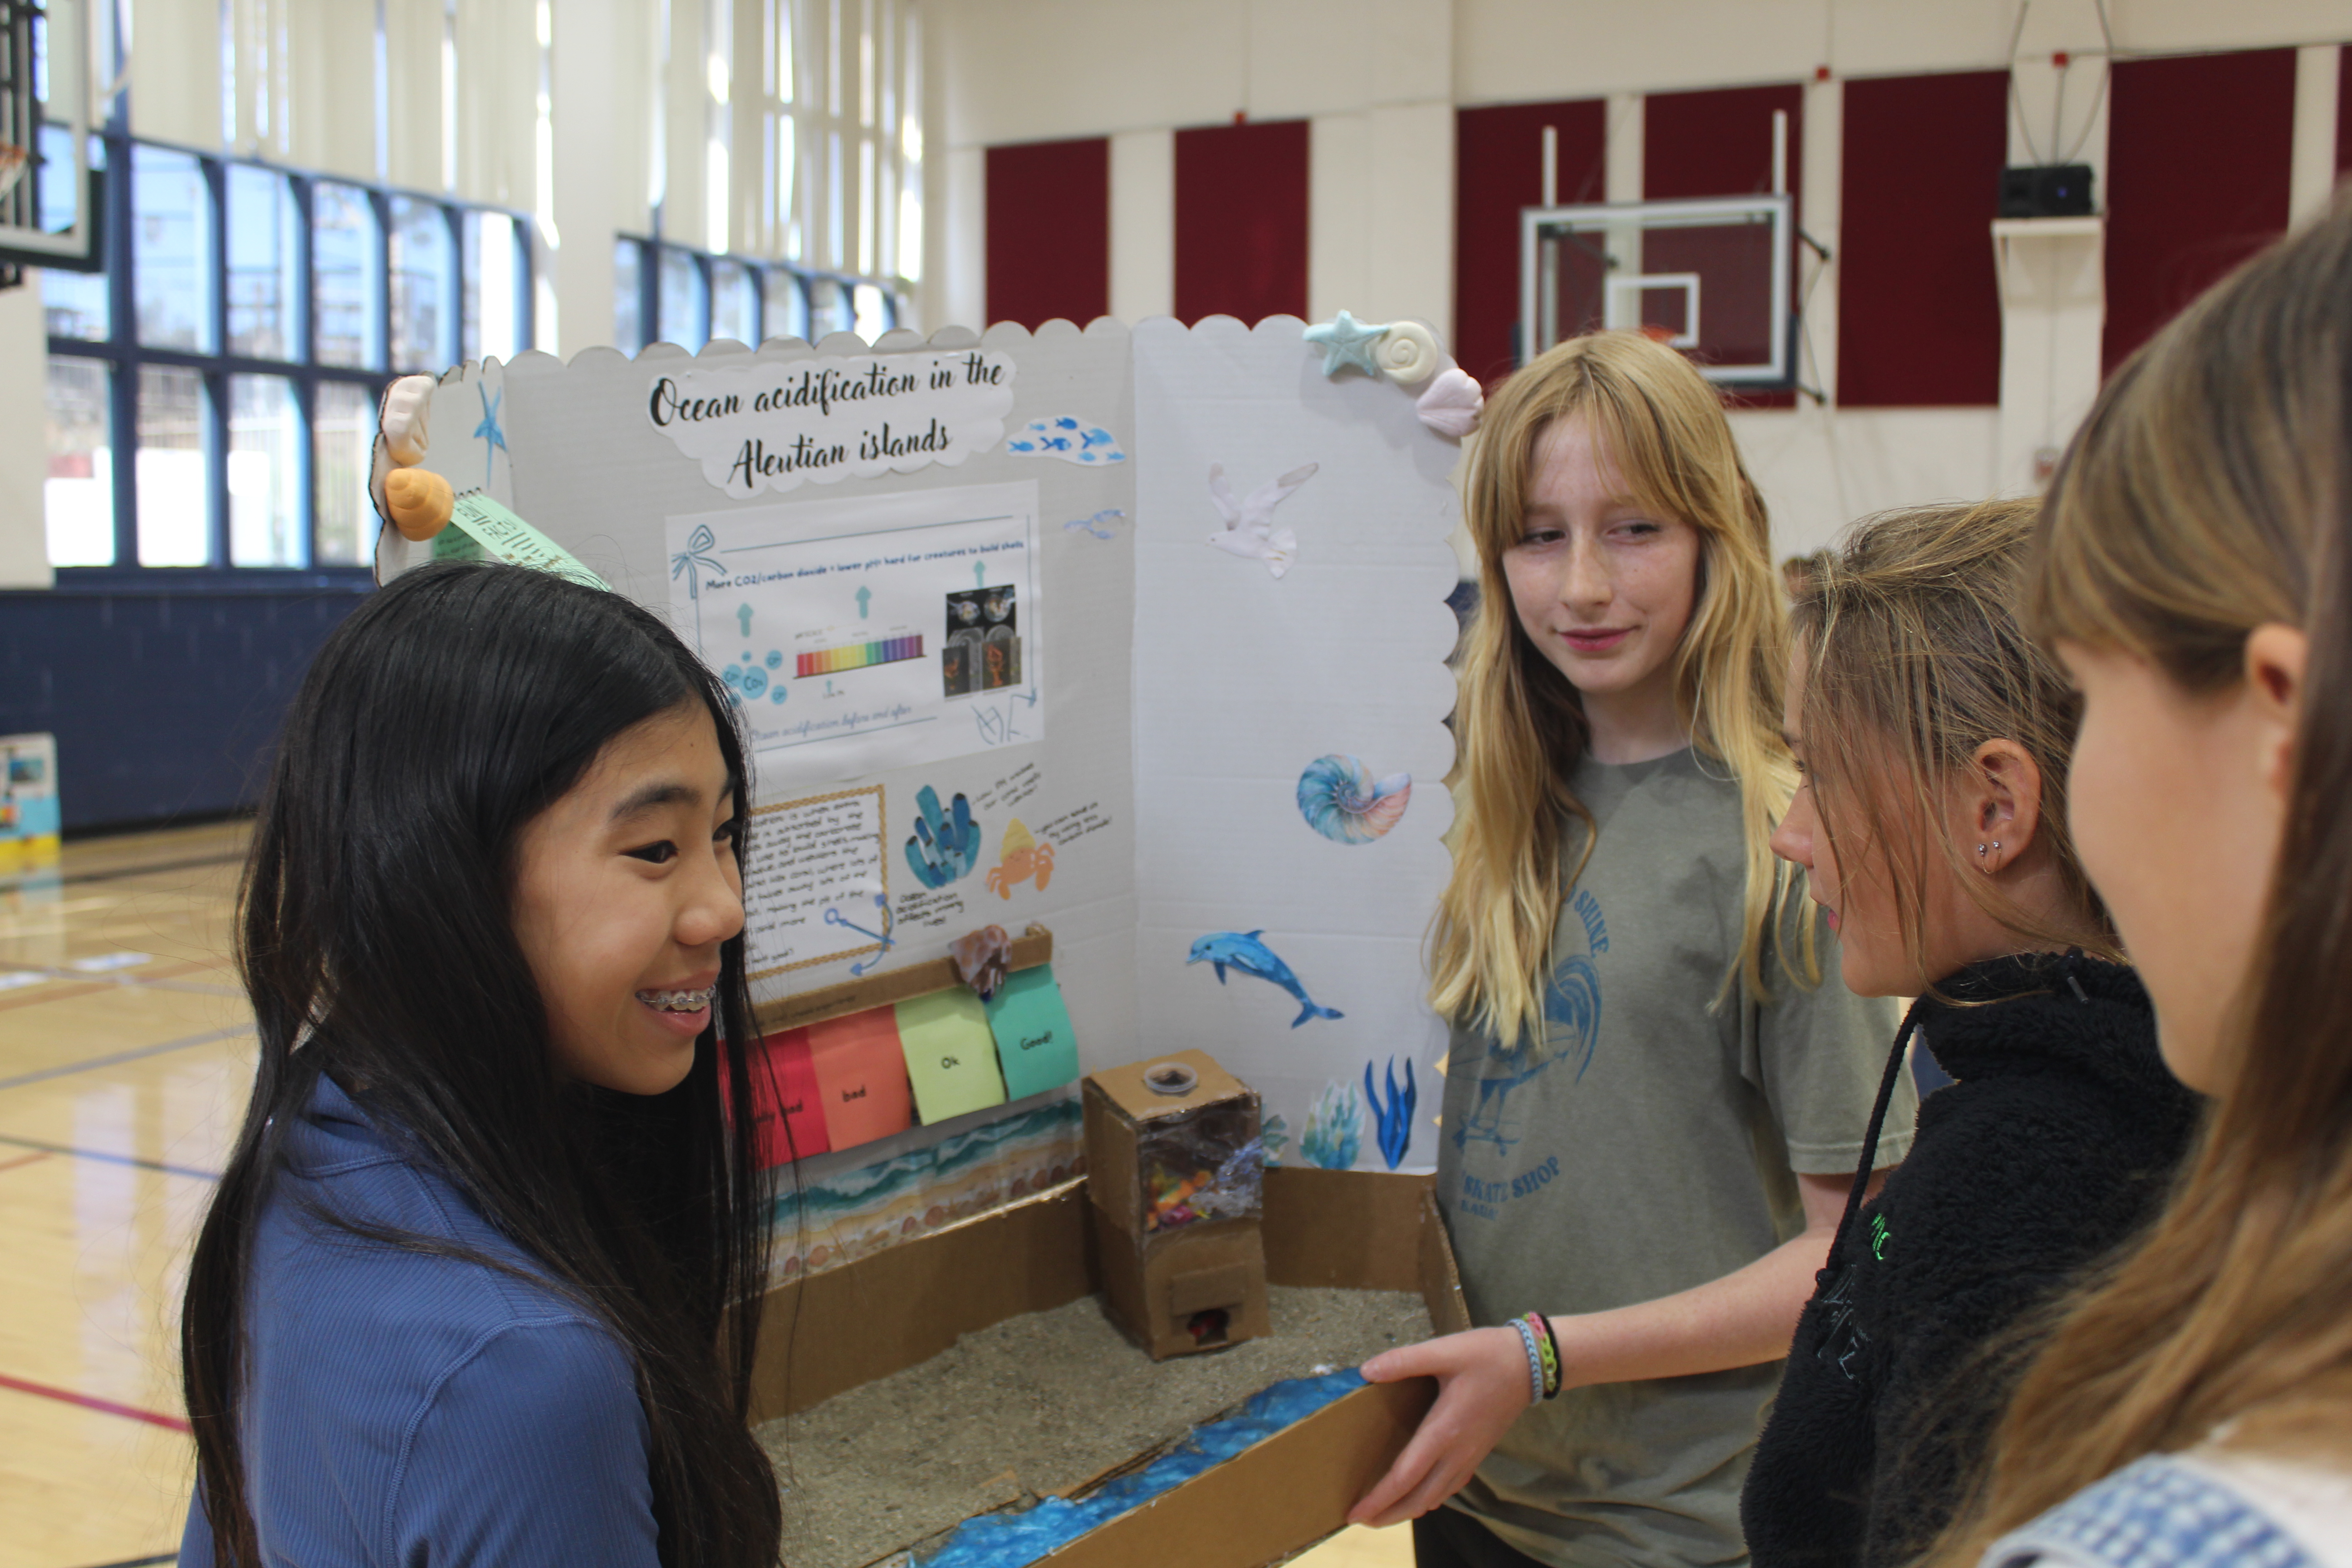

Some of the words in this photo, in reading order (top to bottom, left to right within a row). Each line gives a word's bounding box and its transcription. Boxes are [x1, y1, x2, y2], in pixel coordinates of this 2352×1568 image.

[650, 377, 743, 426] Ocean
[754, 362, 919, 416] acidification
[929, 360, 955, 390] in
[963, 353, 1003, 386] the
[727, 435, 848, 488] Aleutian
[859, 417, 953, 460] islands
[706, 579, 732, 591] More
[1575, 890, 1610, 958] SHINE
[842, 1085, 867, 1103] bad
[1463, 1175, 1509, 1203] SKATE
[1512, 1155, 1560, 1199] SHOP
